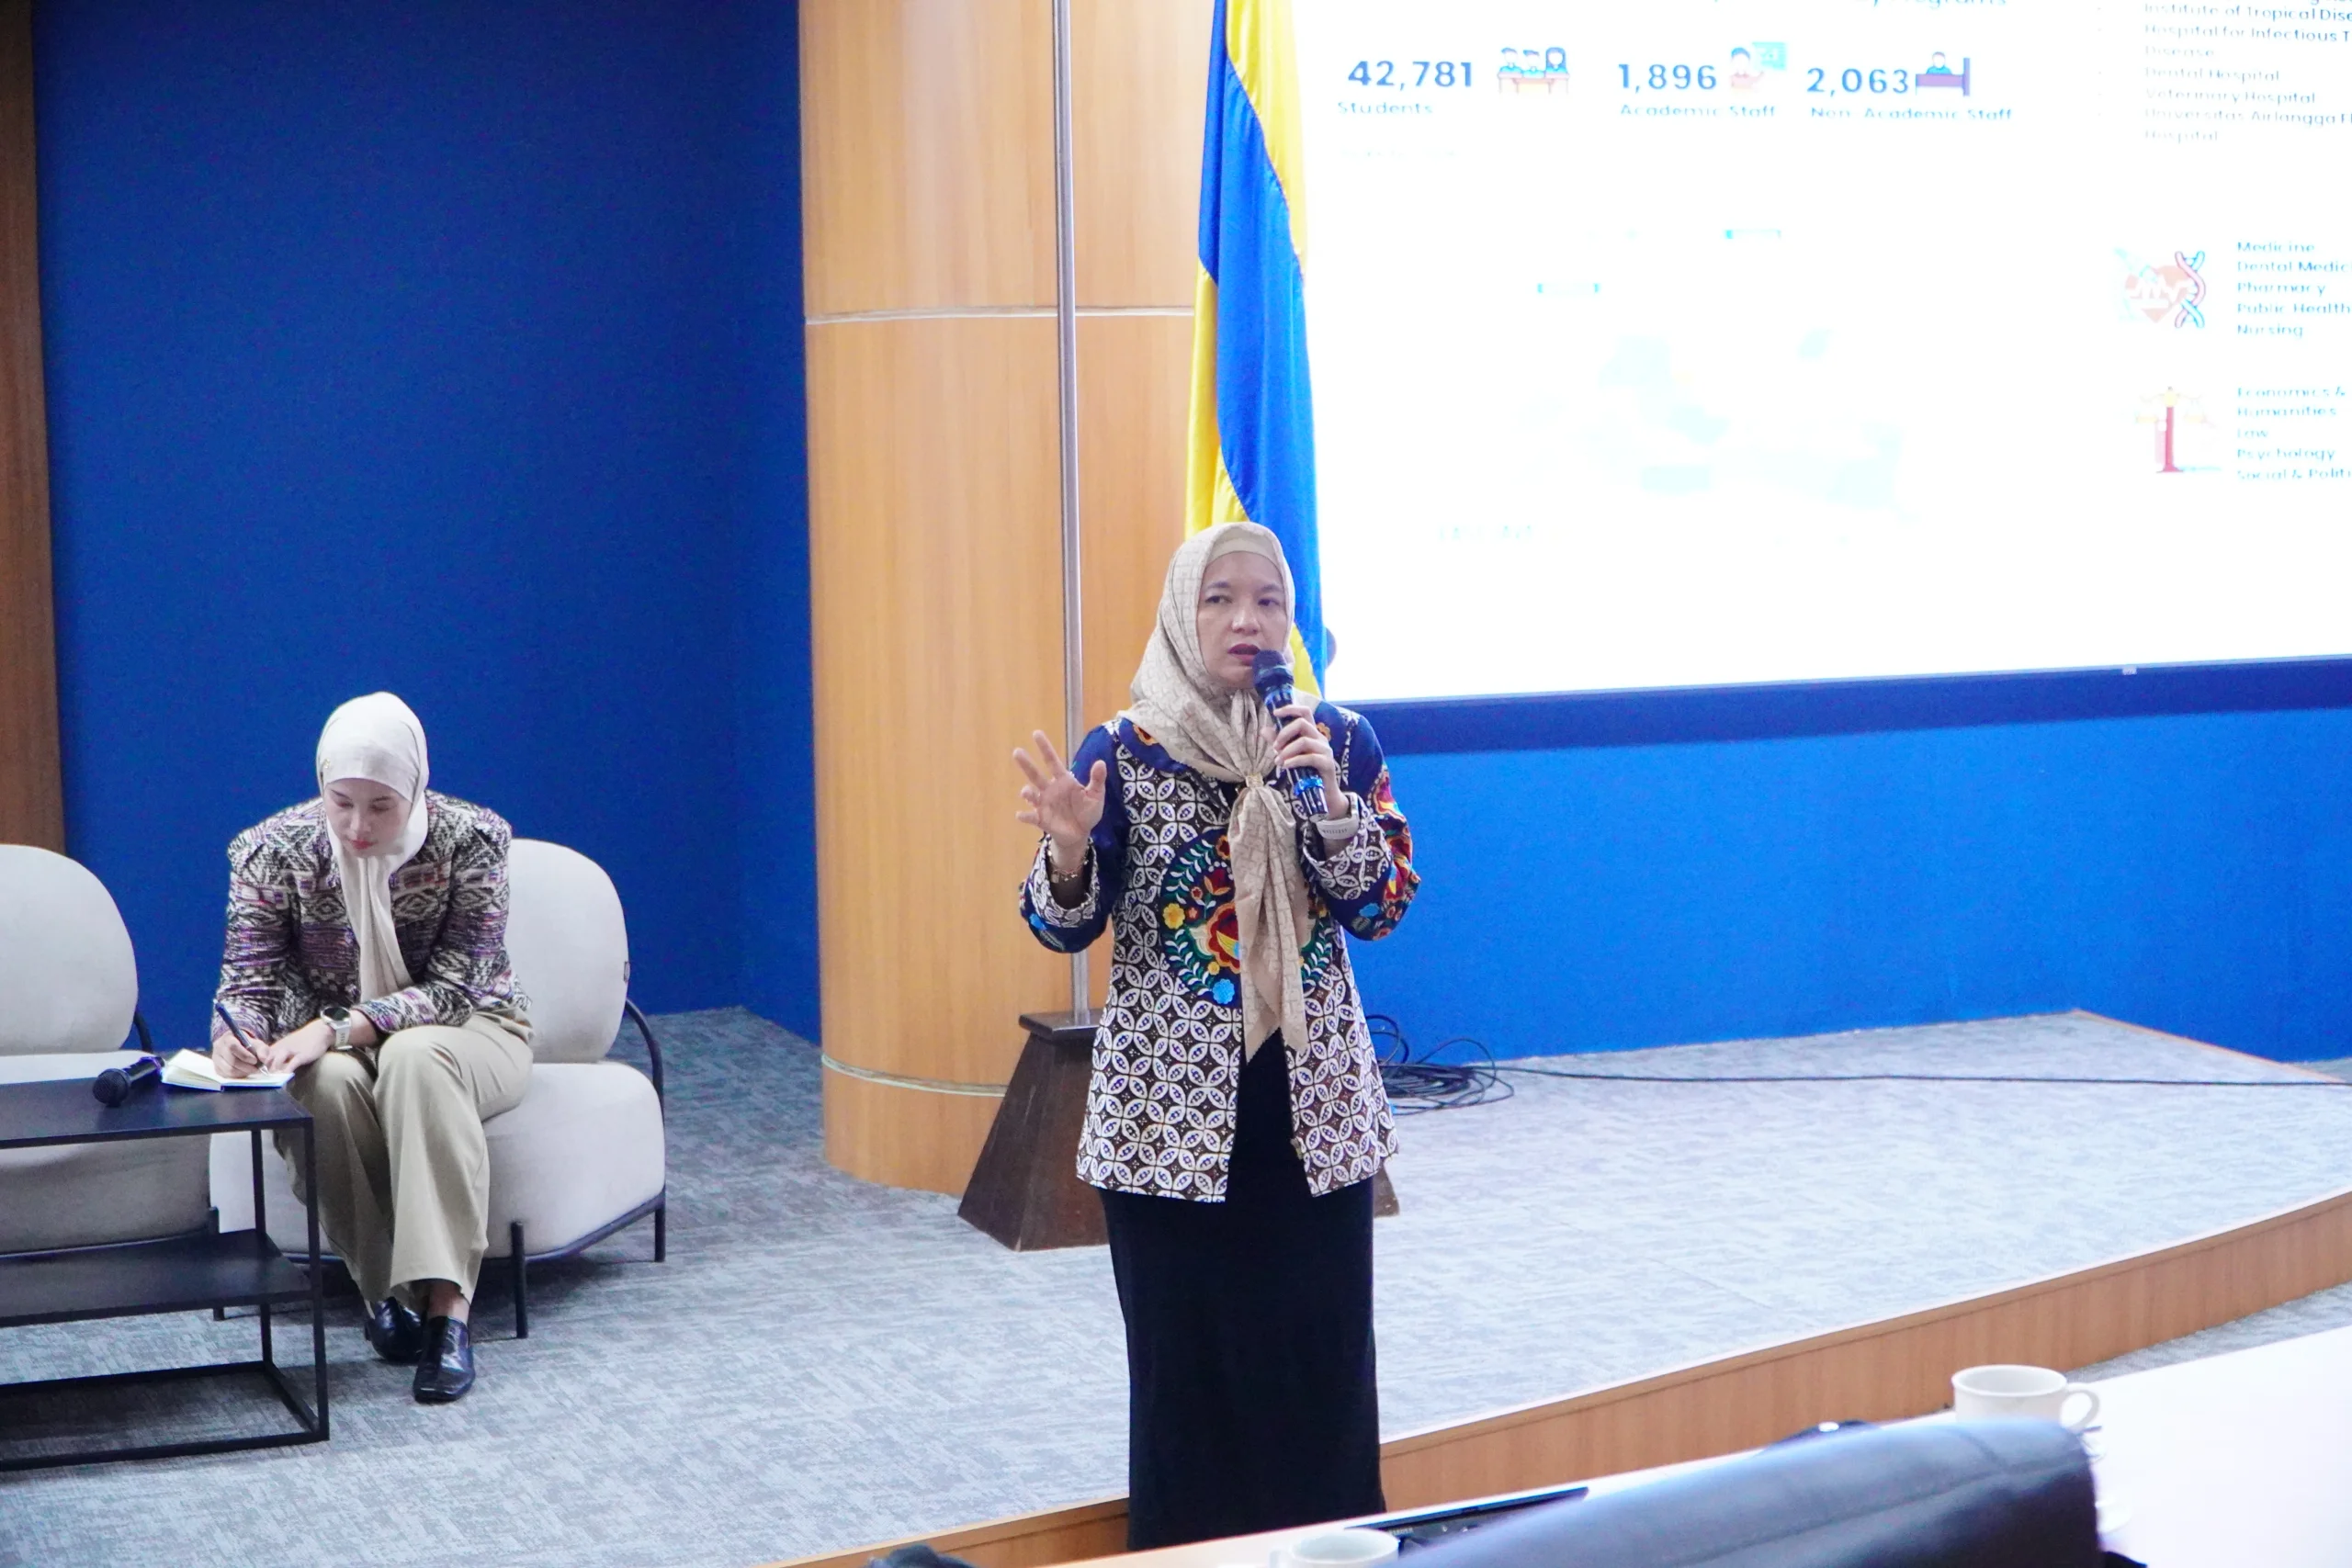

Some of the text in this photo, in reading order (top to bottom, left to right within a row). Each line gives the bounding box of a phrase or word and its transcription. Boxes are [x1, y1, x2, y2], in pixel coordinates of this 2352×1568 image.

[2144, 3, 2219, 16] Institute
[2224, 5, 2241, 16] of
[2247, 6, 2316, 22] Tropical
[2144, 24, 2218, 39] Hospital
[2222, 26, 2245, 39] for
[2251, 28, 2337, 42] Infectious
[2144, 46, 2215, 57] Disease
[1348, 60, 1472, 92] 42,781
[1618, 63, 1717, 94] 1,896
[1806, 67, 1909, 97] 2,063
[2144, 67, 2280, 84] Dental Hospital
[2245, 91, 2316, 106] Hospital
[1338, 101, 1434, 115] Students
[1620, 104, 1776, 118] Academic Staff
[1967, 107, 2012, 120] Staff
[2251, 110, 2336, 128] Airlangga
[2237, 241, 2315, 253] Medicine
[2237, 260, 2293, 273] Dental
[2237, 281, 2326, 298] Pharmacy
[2237, 302, 2351, 314] Public Health
[2237, 323, 2303, 339] Nursing
[2237, 387, 2330, 398] Economics
[2237, 406, 2336, 417] Humanities
[2237, 447, 2335, 462] Psychology
[2237, 468, 2287, 480] Social
